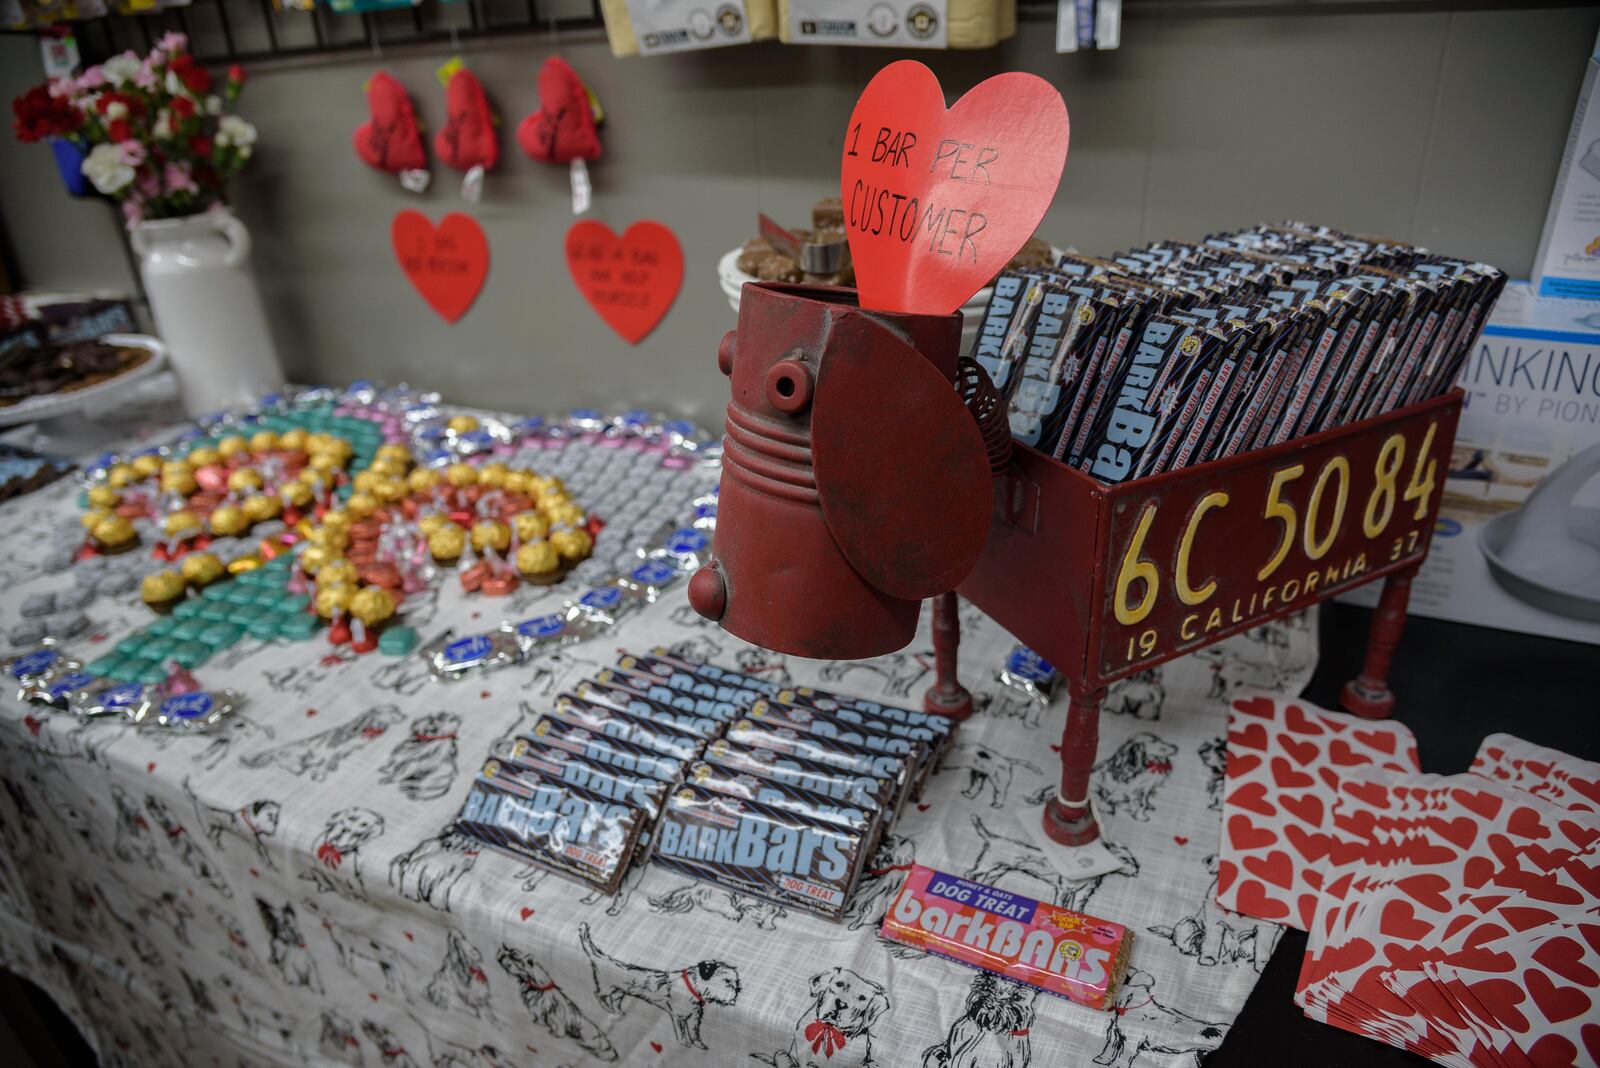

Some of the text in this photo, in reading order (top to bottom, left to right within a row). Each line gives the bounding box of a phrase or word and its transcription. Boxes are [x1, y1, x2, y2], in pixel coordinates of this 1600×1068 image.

[848, 122, 998, 185] 1 BAR PER
[850, 179, 988, 265] CUSTOMER
[1008, 293, 1069, 447] BARKBa
[1103, 350, 1121, 381] COOKIE
[1116, 332, 1130, 352] BAR
[1292, 383, 1310, 410] CAROB
[1307, 350, 1324, 381] COOKIE
[1321, 333, 1334, 351] BAR
[1329, 342, 1348, 371] COOKIE
[1344, 323, 1356, 341] BAR
[1462, 343, 1600, 398] INKIN
[1055, 425, 1073, 459] USCIOUS
[1095, 340, 1106, 359] BAR
[1092, 321, 1176, 482] BARKBa
[1164, 372, 1209, 456] CAROB COOKIE BAR
[1188, 417, 1206, 446] CAROB
[1203, 384, 1222, 415] COOKIE
[1218, 363, 1232, 383] BAR
[1212, 407, 1228, 435] CAROB
[1226, 374, 1245, 405] COOKIE
[1242, 354, 1255, 373] BAR
[1239, 406, 1257, 434] CAROB
[1255, 374, 1273, 404] COOKIE
[1271, 354, 1284, 373] BAR
[1495, 393, 1527, 415] BY
[1537, 397, 1600, 425] PION
[1127, 531, 1420, 661] 19 CALIFORNIA 37
[659, 814, 851, 880] BARKBars
[806, 884, 835, 902] TREAT
[931, 880, 1030, 919] DOG TREAT
[956, 878, 983, 892] HONEY
[991, 889, 1014, 901] OATS
[893, 889, 1110, 985] barkBARS
